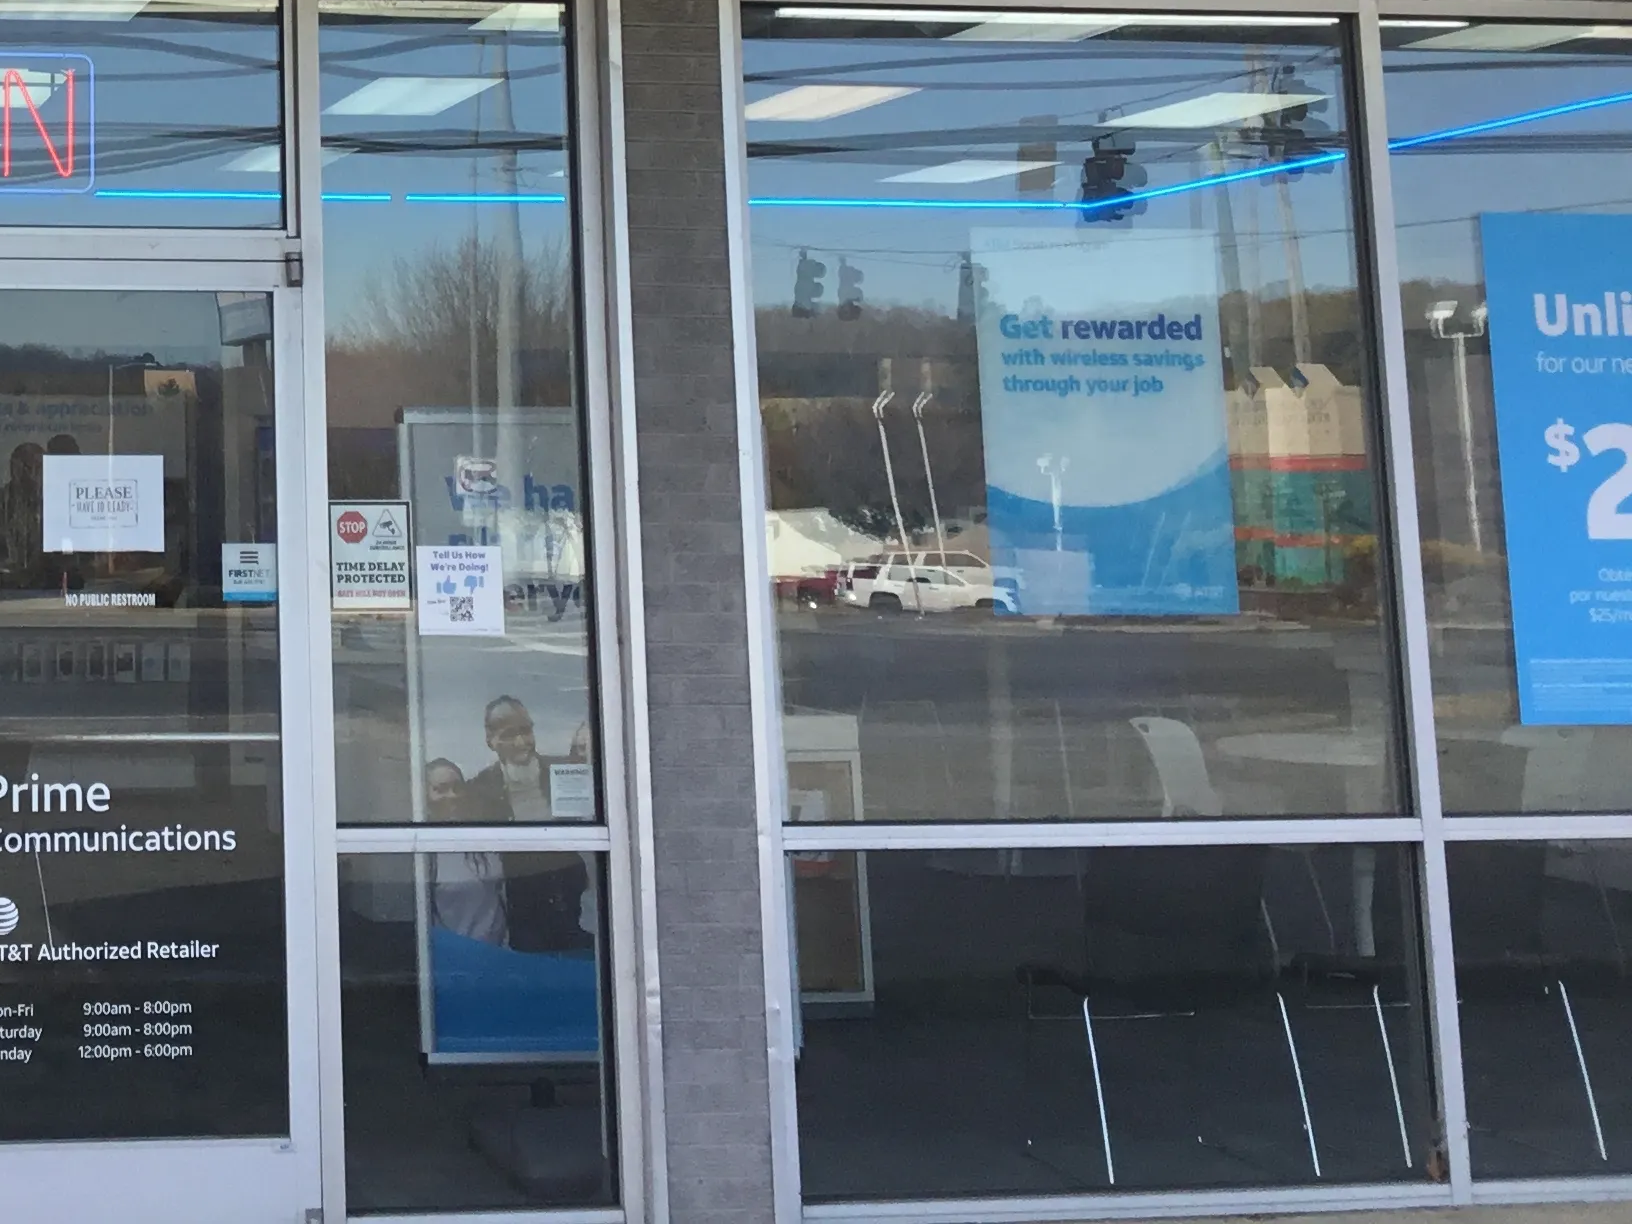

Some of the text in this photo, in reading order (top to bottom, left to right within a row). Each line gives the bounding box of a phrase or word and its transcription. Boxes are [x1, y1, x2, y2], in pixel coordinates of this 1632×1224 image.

[999, 314, 1203, 341] Get rewarded
[1001, 349, 1205, 371] with wireless savings
[1535, 351, 1567, 373] for
[1571, 357, 1607, 373] our
[1002, 375, 1164, 397] through your job
[76, 486, 133, 500] PLEASE
[339, 521, 366, 534] STOP
[432, 551, 486, 559] Tell Us How
[336, 562, 405, 572] TIME DELAY
[430, 563, 489, 573] We're Doing!
[336, 574, 406, 584] PROTECTED
[65, 593, 156, 607] NO PUBLIC RESTROOM
[37, 941, 142, 961] Authorized
[147, 940, 220, 959] Retailer
[83, 1002, 131, 1015] 9:00am
[143, 1001, 192, 1016] 8:00pm
[83, 1024, 131, 1037] 9:00am
[143, 1023, 192, 1038] 8:00pm
[78, 1045, 132, 1060] 12:00pm
[144, 1044, 193, 1060] 6:00pm
